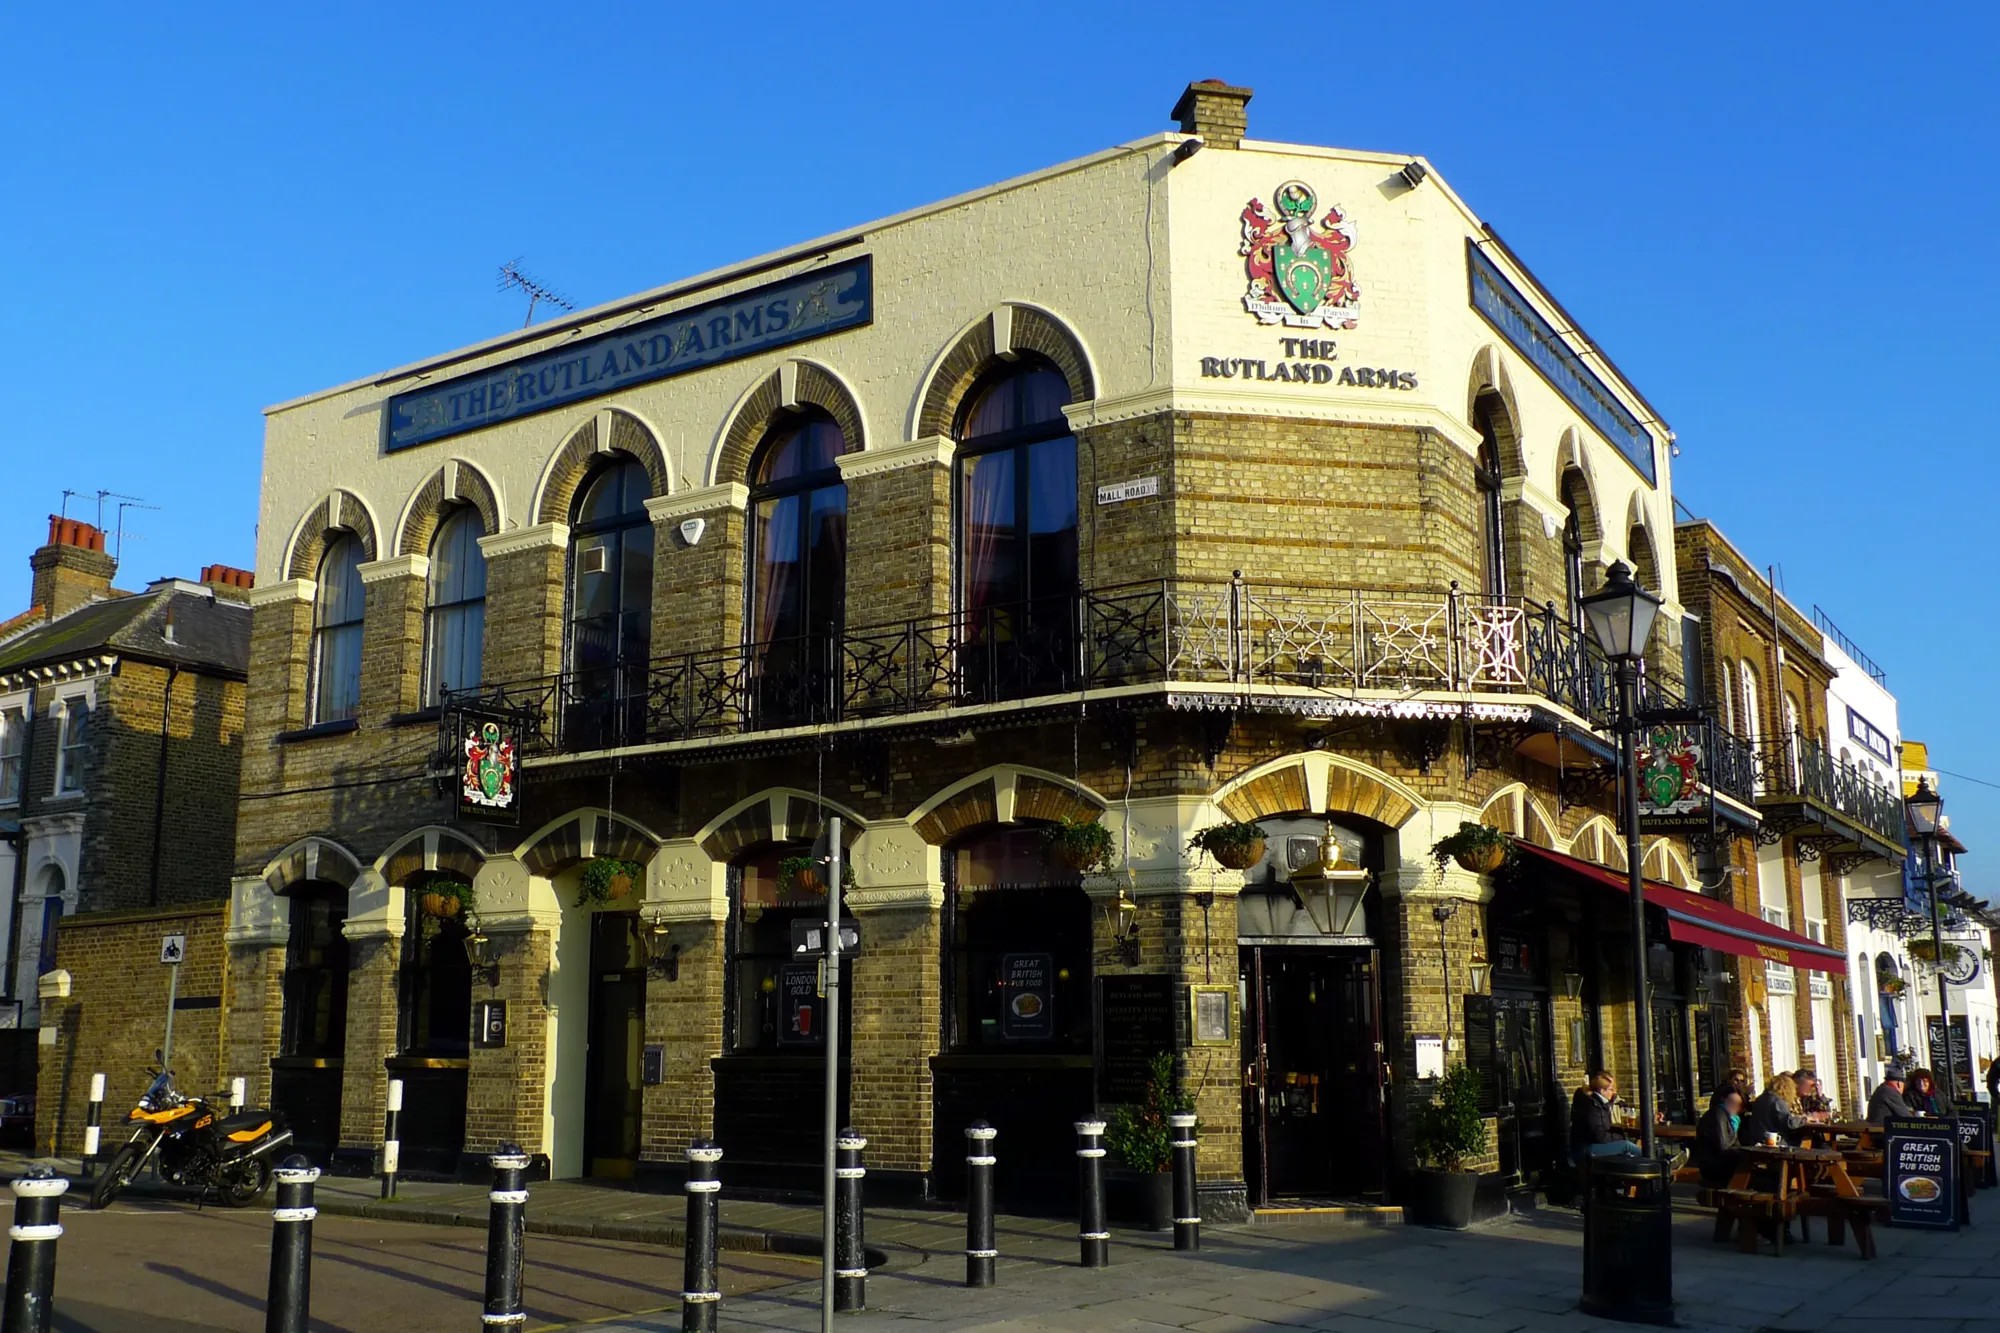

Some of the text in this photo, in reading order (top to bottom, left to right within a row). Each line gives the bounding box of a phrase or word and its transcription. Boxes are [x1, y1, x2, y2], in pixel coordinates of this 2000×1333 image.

[1278, 337, 1338, 361] THE
[447, 298, 791, 423] THE RUTLAND ARMS
[1199, 356, 1419, 391] RUTLAND ARMS
[1099, 490, 1122, 503] MALL
[1641, 818, 1682, 826] RUTLAND
[1013, 959, 1041, 969] GREAT
[1011, 969, 1043, 979] BRITISH
[785, 975, 817, 985] LONDON
[1012, 979, 1043, 988] PUB FOOD
[791, 985, 812, 996] GOLD
[1105, 1006, 1169, 1015] QUALITY FOOD
[1910, 1123, 1950, 1131] RUTLAND
[1902, 1142, 1938, 1153] GREAT
[1899, 1152, 1941, 1163] BRITISH
[1899, 1162, 1941, 1172] PUB FOOD
